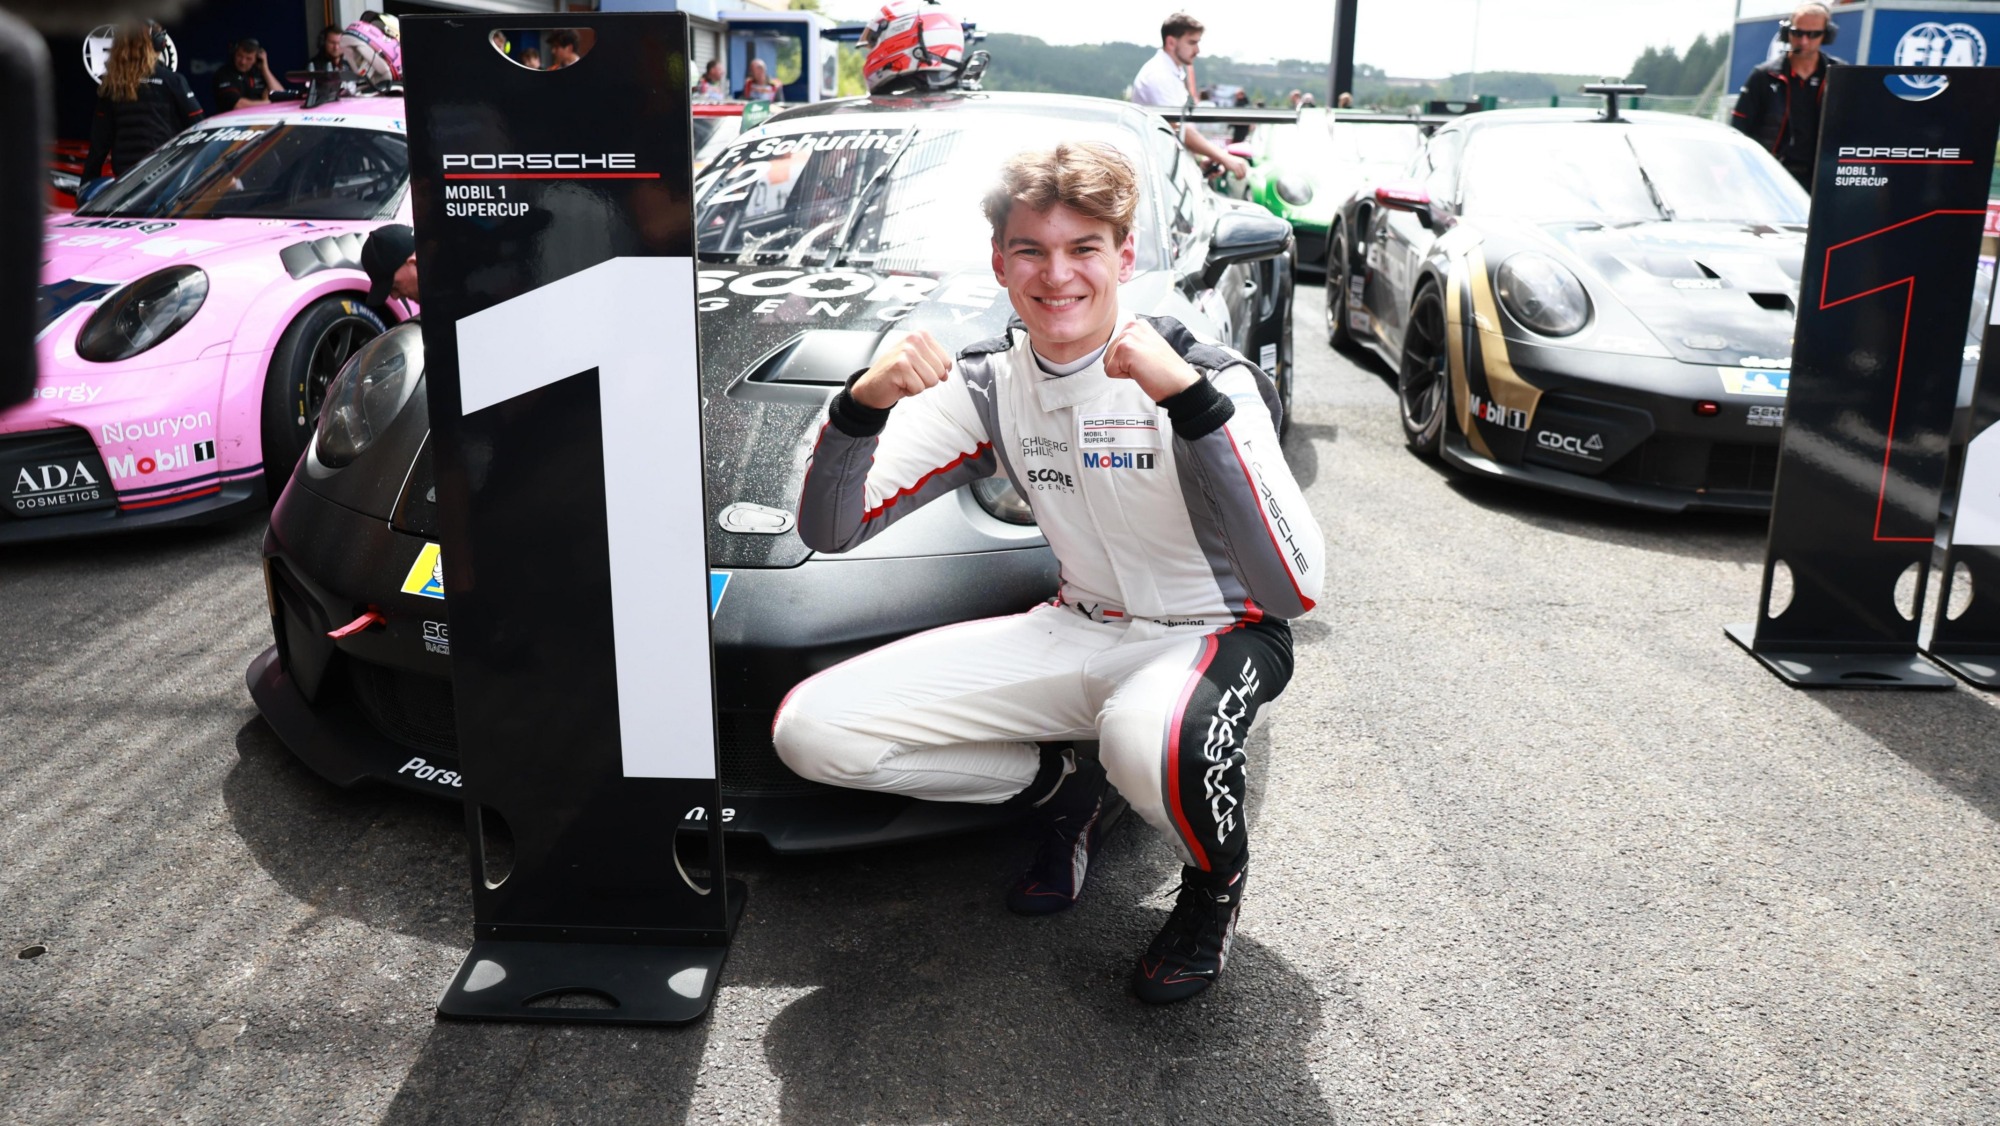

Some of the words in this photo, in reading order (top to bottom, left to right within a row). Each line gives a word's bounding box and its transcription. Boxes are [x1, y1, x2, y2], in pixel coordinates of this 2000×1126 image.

[204, 127, 265, 142] Haar
[750, 129, 906, 159] Schuring
[1838, 147, 1960, 158] PORSCHE
[442, 153, 636, 169] PORSCHE
[1836, 166, 1868, 175] MOBIL
[1869, 166, 1876, 175] 1
[1835, 176, 1888, 187] SUPERCUP
[445, 185, 495, 200] MOBIL
[498, 185, 506, 199] 1
[446, 203, 529, 217] SUPERCUP
[1470, 394, 1506, 427] Mobil
[101, 411, 212, 445] Nouryon
[1083, 419, 1155, 427] PORSCHE
[1537, 430, 1589, 455] CDCL
[107, 444, 189, 480] Mobil
[1083, 452, 1133, 469] Mobil
[12, 460, 99, 494] ADA
[1027, 468, 1074, 488] SCORE
[1030, 483, 1076, 495] AGENCY
[16, 490, 100, 510] COSMETICS
[456, 257, 716, 779] 1
[1204, 656, 1260, 846] PORSCHE
